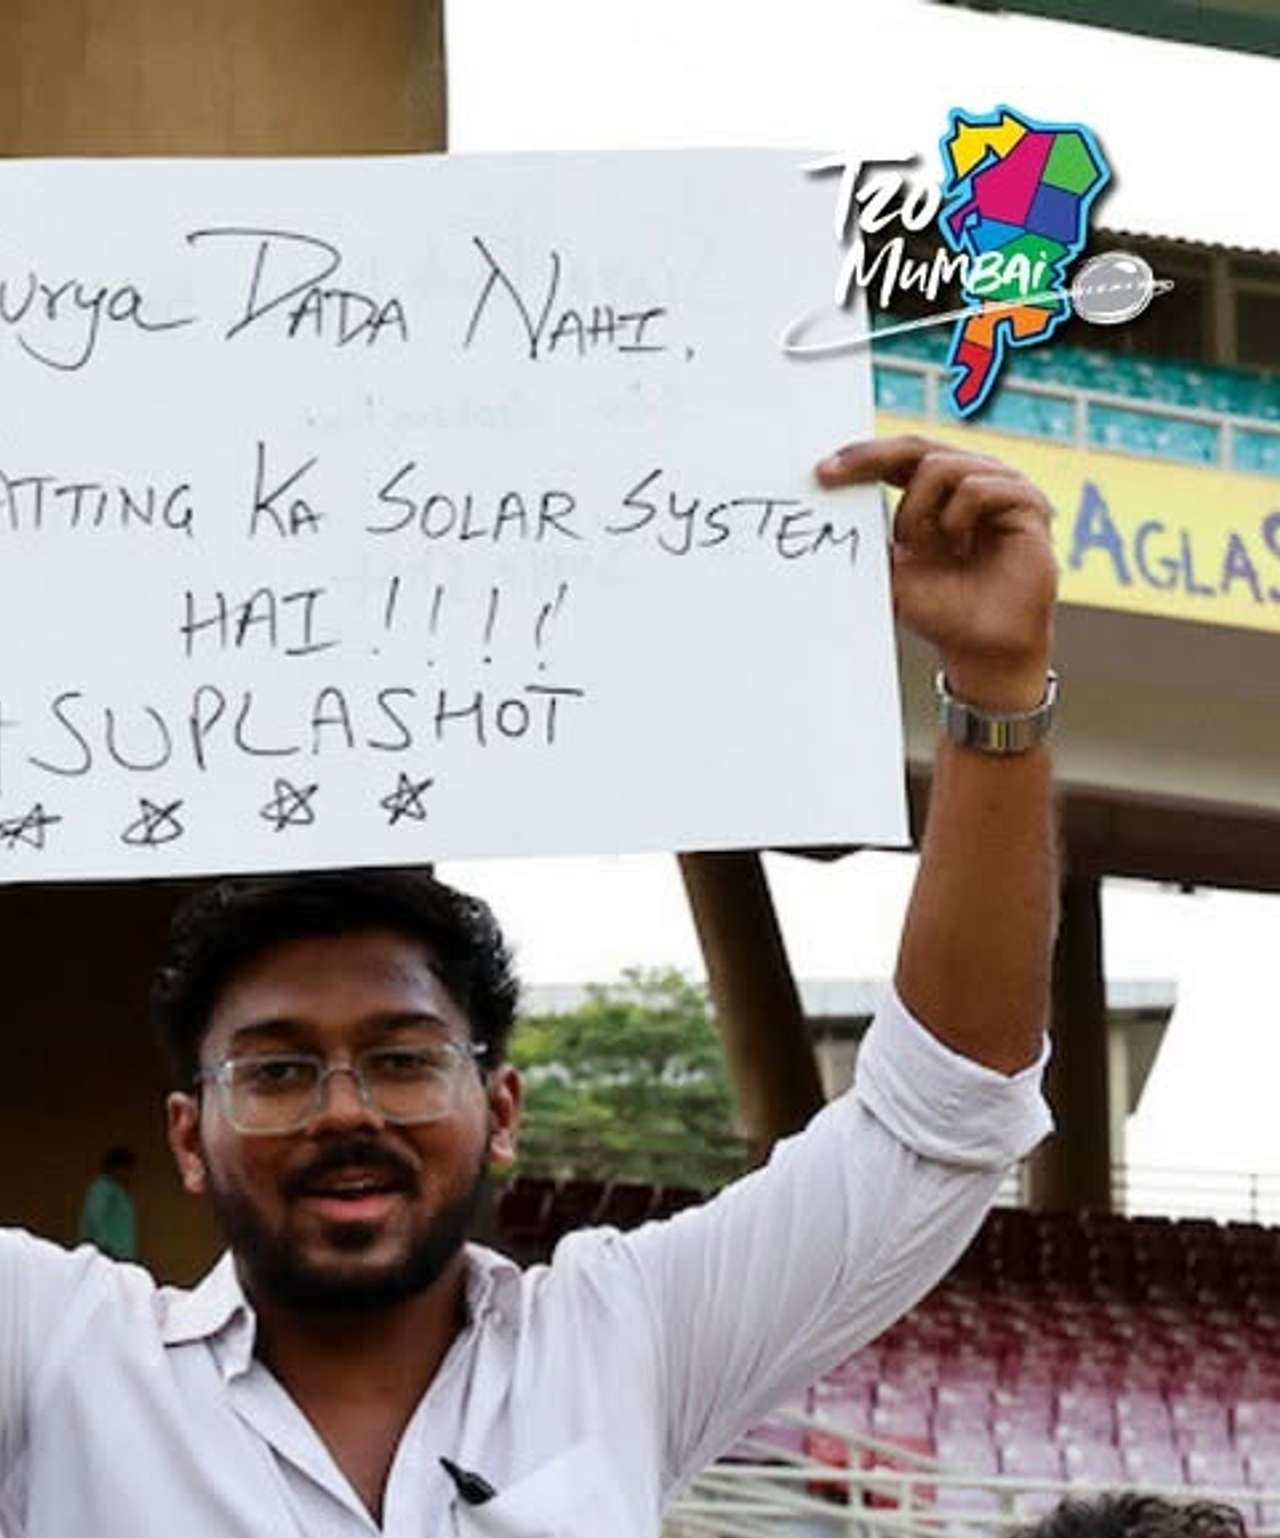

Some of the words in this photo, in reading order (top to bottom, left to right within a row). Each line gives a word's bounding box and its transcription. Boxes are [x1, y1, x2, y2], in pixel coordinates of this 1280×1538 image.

[186, 227, 407, 344] DADA
[366, 461, 582, 540] SOLAR
[604, 468, 861, 565] SYSTEM
[179, 588, 340, 657] HAI
